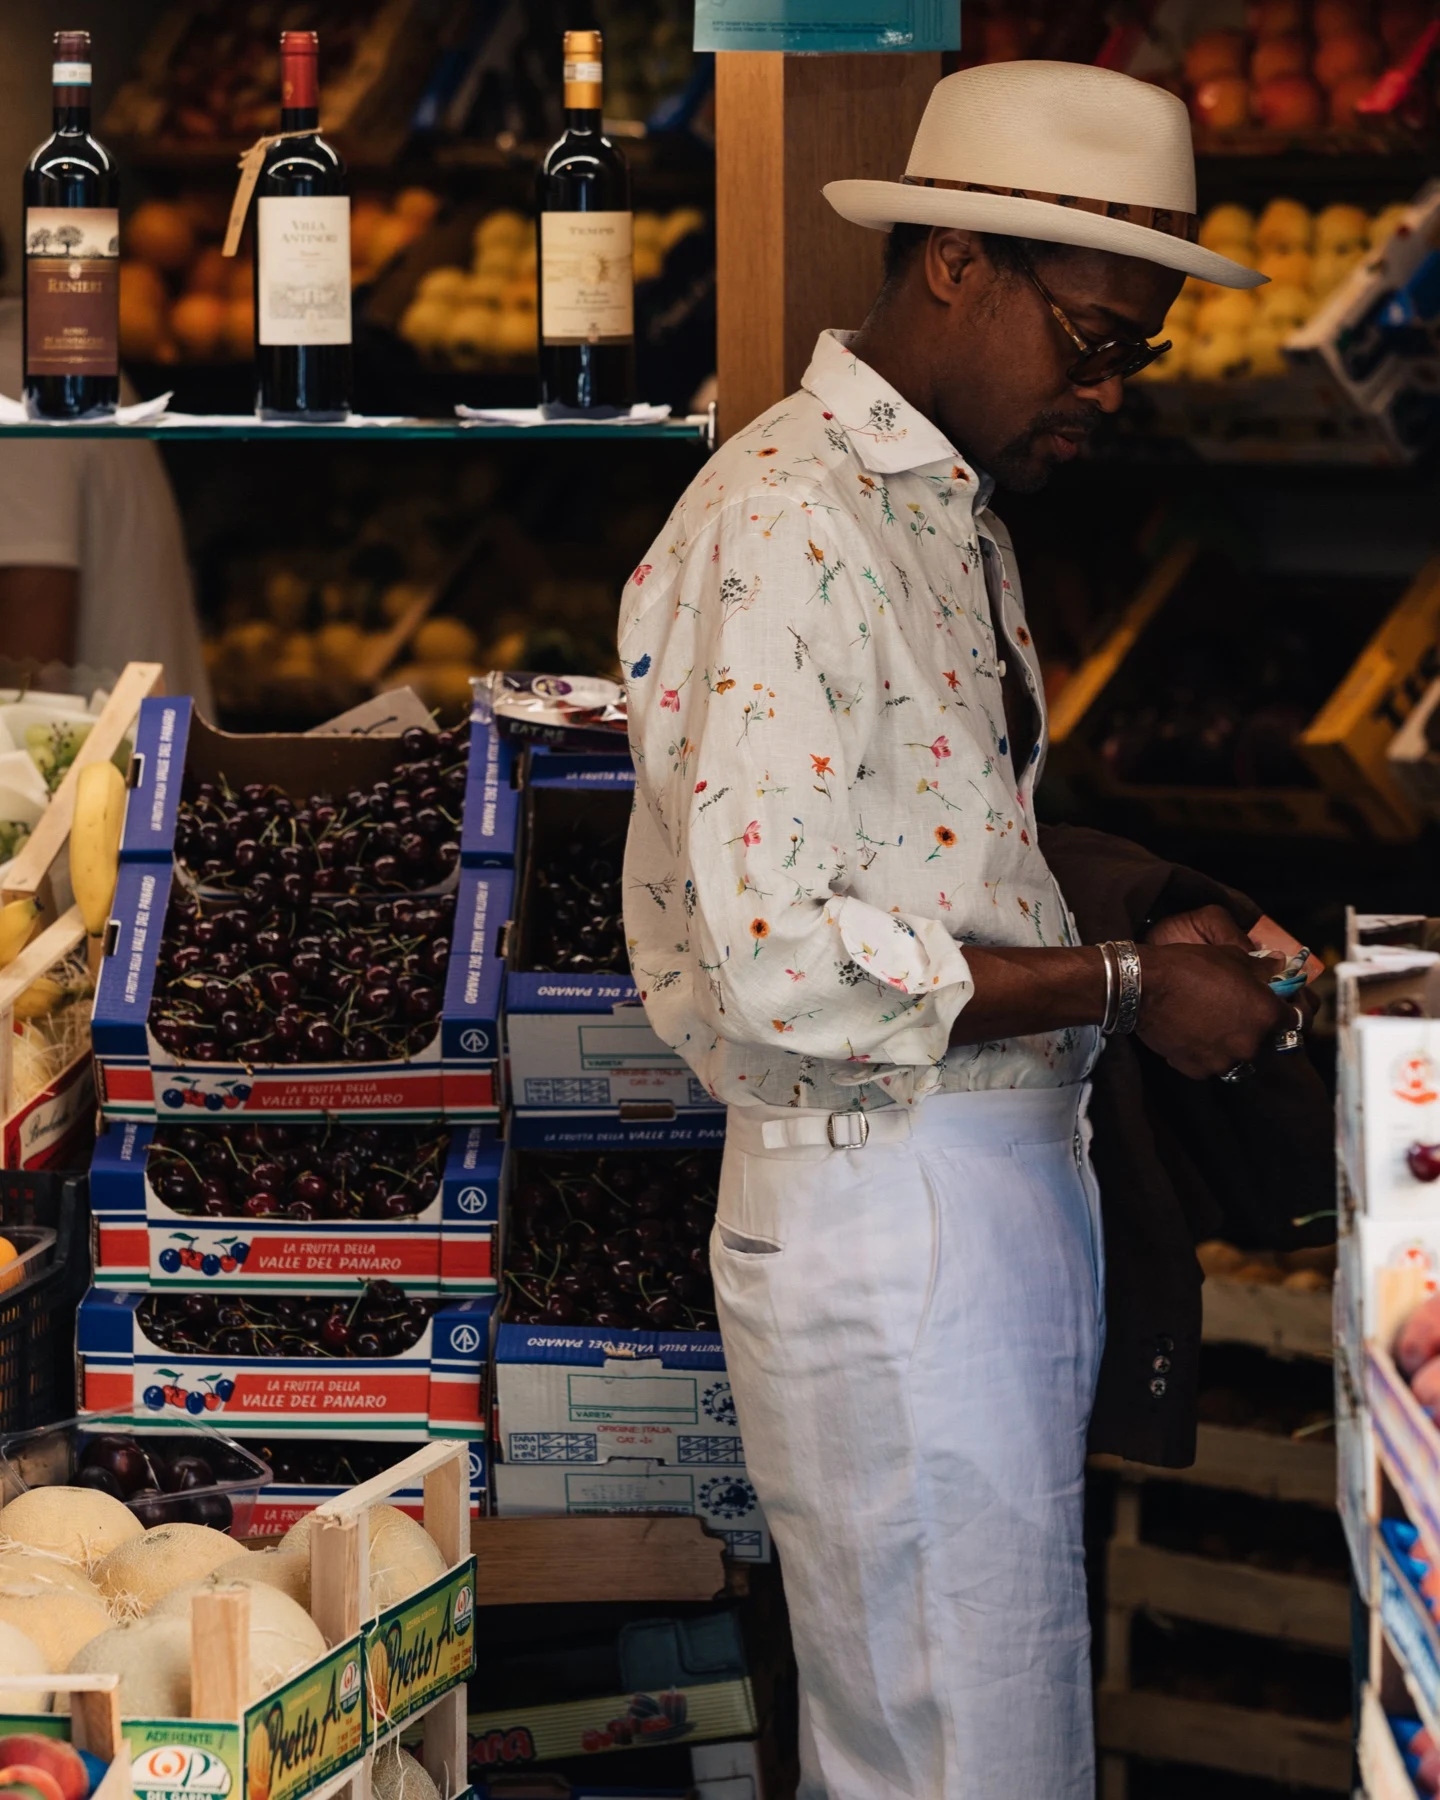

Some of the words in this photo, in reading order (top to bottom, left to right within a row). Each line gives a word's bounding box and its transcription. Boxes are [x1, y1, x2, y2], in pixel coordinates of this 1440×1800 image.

[510, 722, 542, 737] EAT
[543, 730, 565, 742] ME
[537, 986, 593, 997] PANARO
[597, 987, 621, 998] DEL
[285, 1085, 298, 1095] LA
[302, 1084, 342, 1095] FRUTTA
[345, 1082, 378, 1093] DELLA
[262, 1095, 304, 1107] VALLE
[309, 1095, 335, 1106] DEL
[342, 1094, 404, 1105] PANARO
[544, 1134, 555, 1142] LA
[558, 1133, 594, 1142] FRUTTA
[596, 1132, 624, 1141] DELLA
[628, 1130, 665, 1140] VALLE
[669, 1130, 692, 1139] DEL
[283, 1243, 296, 1254] LA
[300, 1243, 340, 1254] FRUTTA
[344, 1243, 376, 1255] DELLA
[259, 1256, 301, 1269] VALLE
[306, 1257, 333, 1269] DEL
[339, 1257, 401, 1270] PANARO
[527, 1337, 582, 1349] PANARO
[588, 1339, 611, 1351] DEL
[659, 1343, 686, 1352] DELLA
[267, 1380, 280, 1392] LA
[283, 1380, 325, 1392] FRUTTA
[328, 1381, 360, 1392] DELLA
[242, 1394, 285, 1407] VALLE
[290, 1394, 317, 1408] DEL
[323, 1395, 387, 1408] PANARO
[642, 1426, 673, 1434] ITALIA
[264, 1509, 277, 1520] LA
[145, 1730, 213, 1745] ADERENTE
